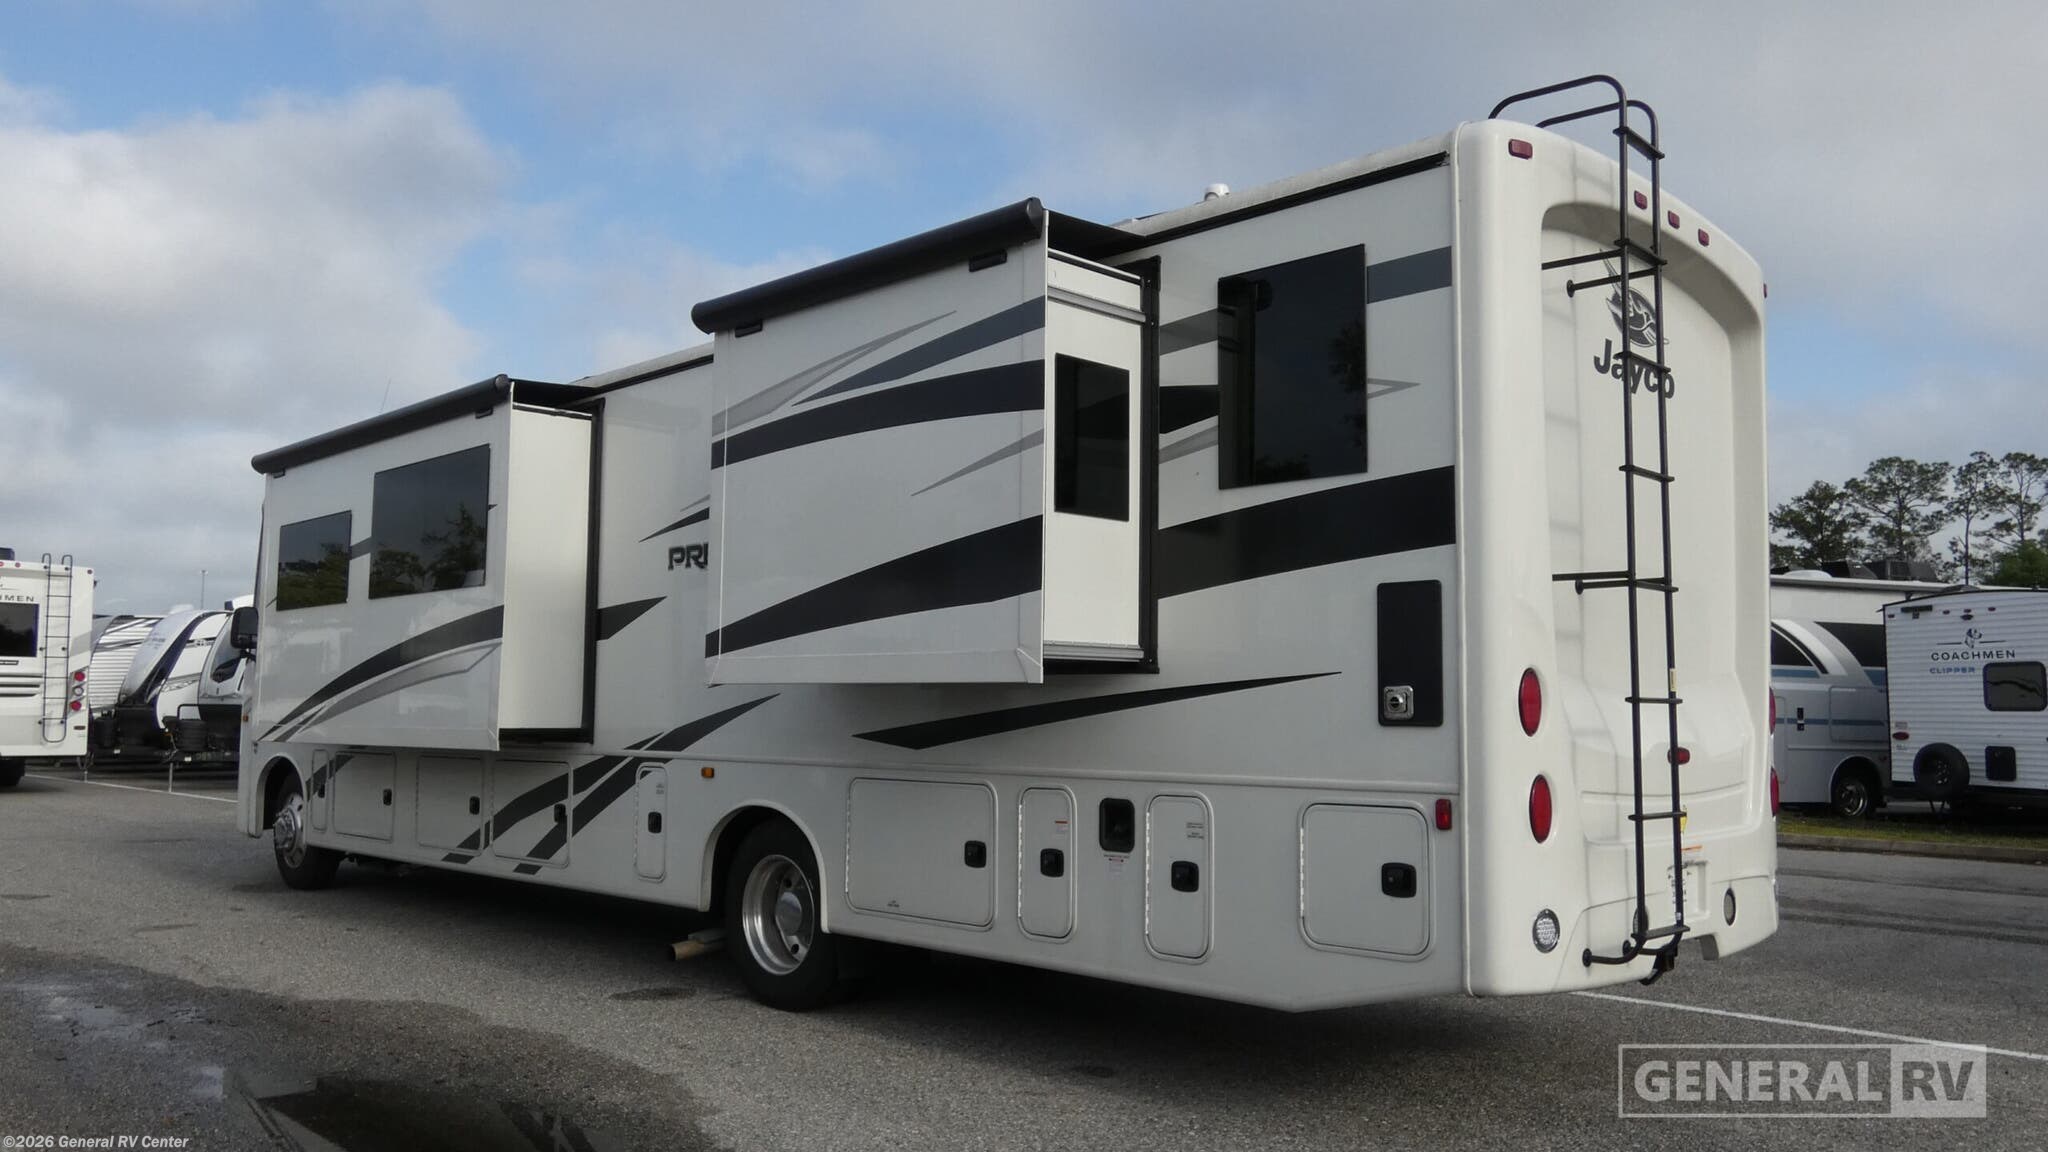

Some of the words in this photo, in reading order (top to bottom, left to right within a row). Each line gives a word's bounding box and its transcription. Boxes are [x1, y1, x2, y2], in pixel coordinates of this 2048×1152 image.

[0, 594, 34, 602] MEN
[1930, 650, 2016, 661] COACHMEN
[1929, 666, 1976, 674] CLIPPER
